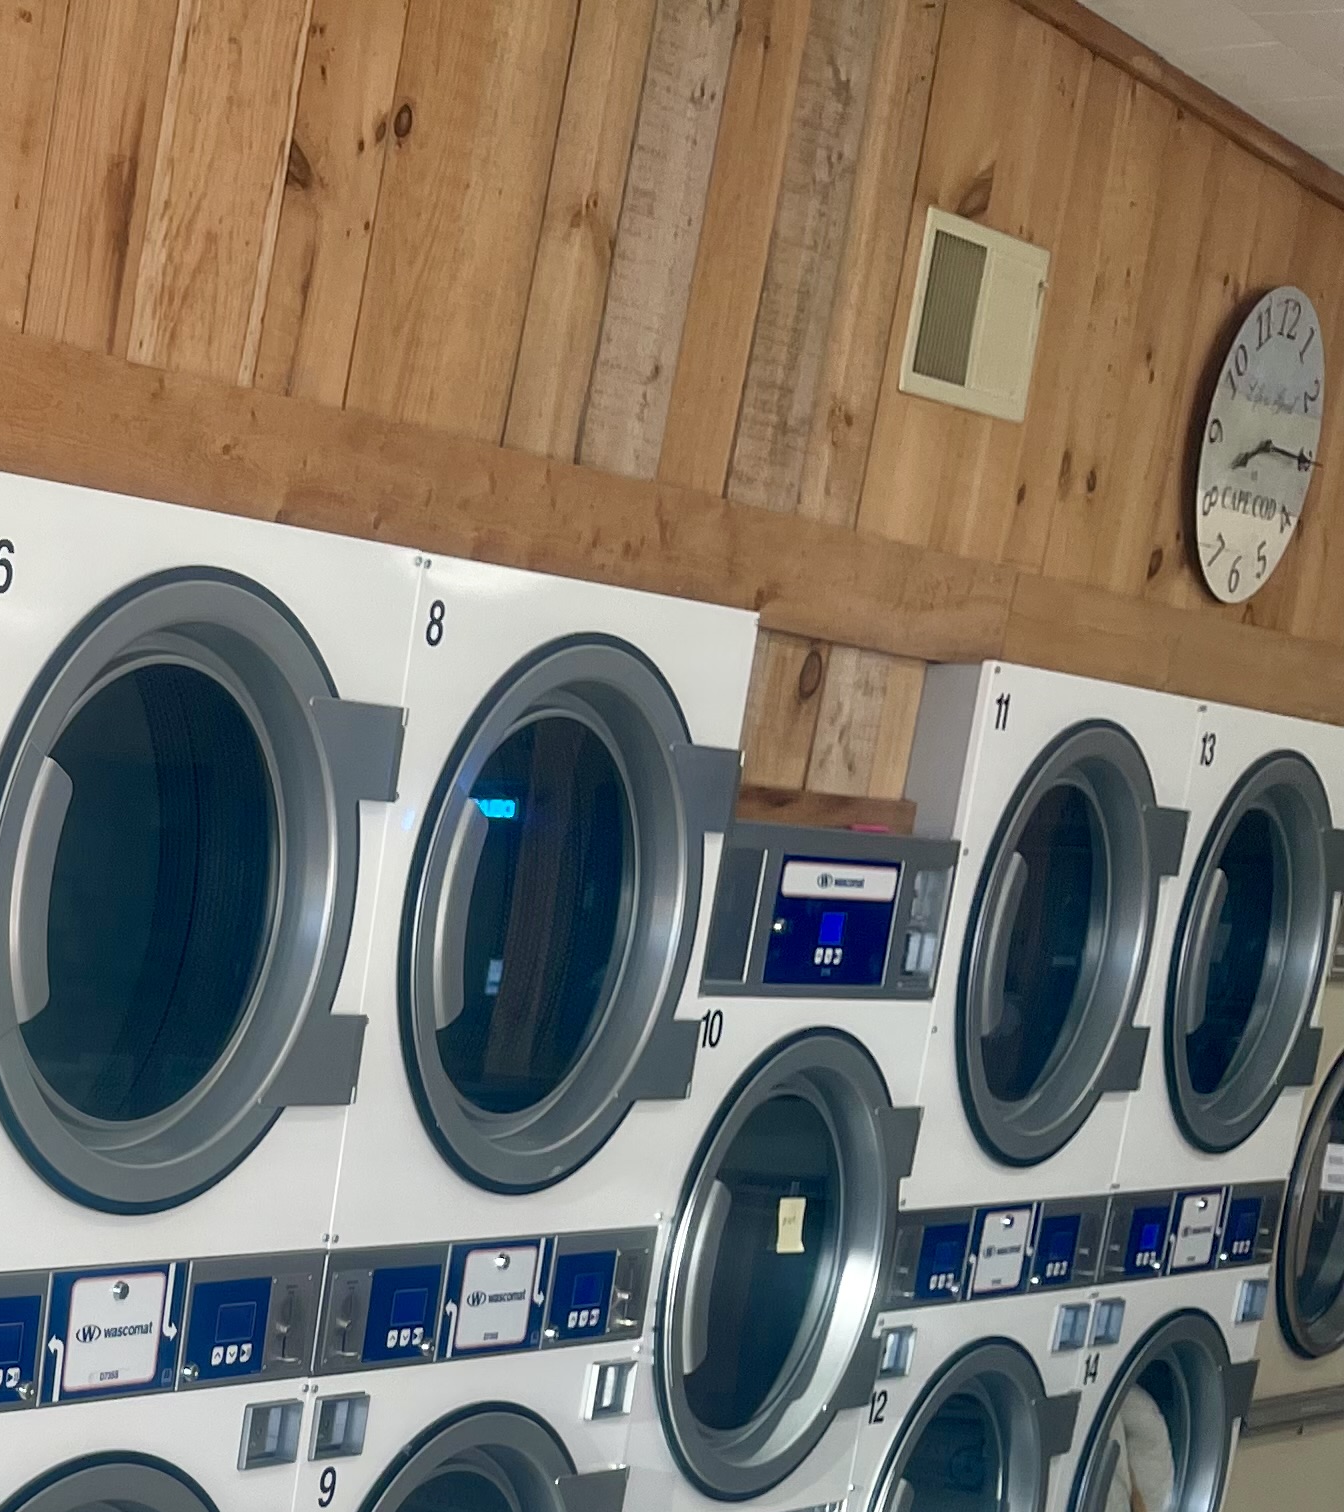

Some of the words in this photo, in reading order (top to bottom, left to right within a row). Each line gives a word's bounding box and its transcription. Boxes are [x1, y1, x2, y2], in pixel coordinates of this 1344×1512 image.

[1256, 296, 1273, 352] 11
[1277, 298, 1302, 341] 12
[1299, 325, 1315, 365] 1
[1225, 343, 1249, 401] 10
[1303, 377, 1321, 414] 2
[1208, 417, 1224, 444] 9
[1202, 485, 1219, 516] 8
[1252, 494, 1277, 521] COD
[1207, 532, 1226, 567] 7
[1255, 540, 1267, 580] 5
[1228, 555, 1243, 594] 6
[425, 599, 446, 647] 8
[995, 692, 1011, 731] 11
[1200, 731, 1217, 767] 13
[701, 1009, 724, 1049] 10
[103, 1320, 154, 1339] wascomat
[1083, 1352, 1100, 1386] 14
[868, 1390, 889, 1425] 12
[317, 1465, 337, 1508] 9
